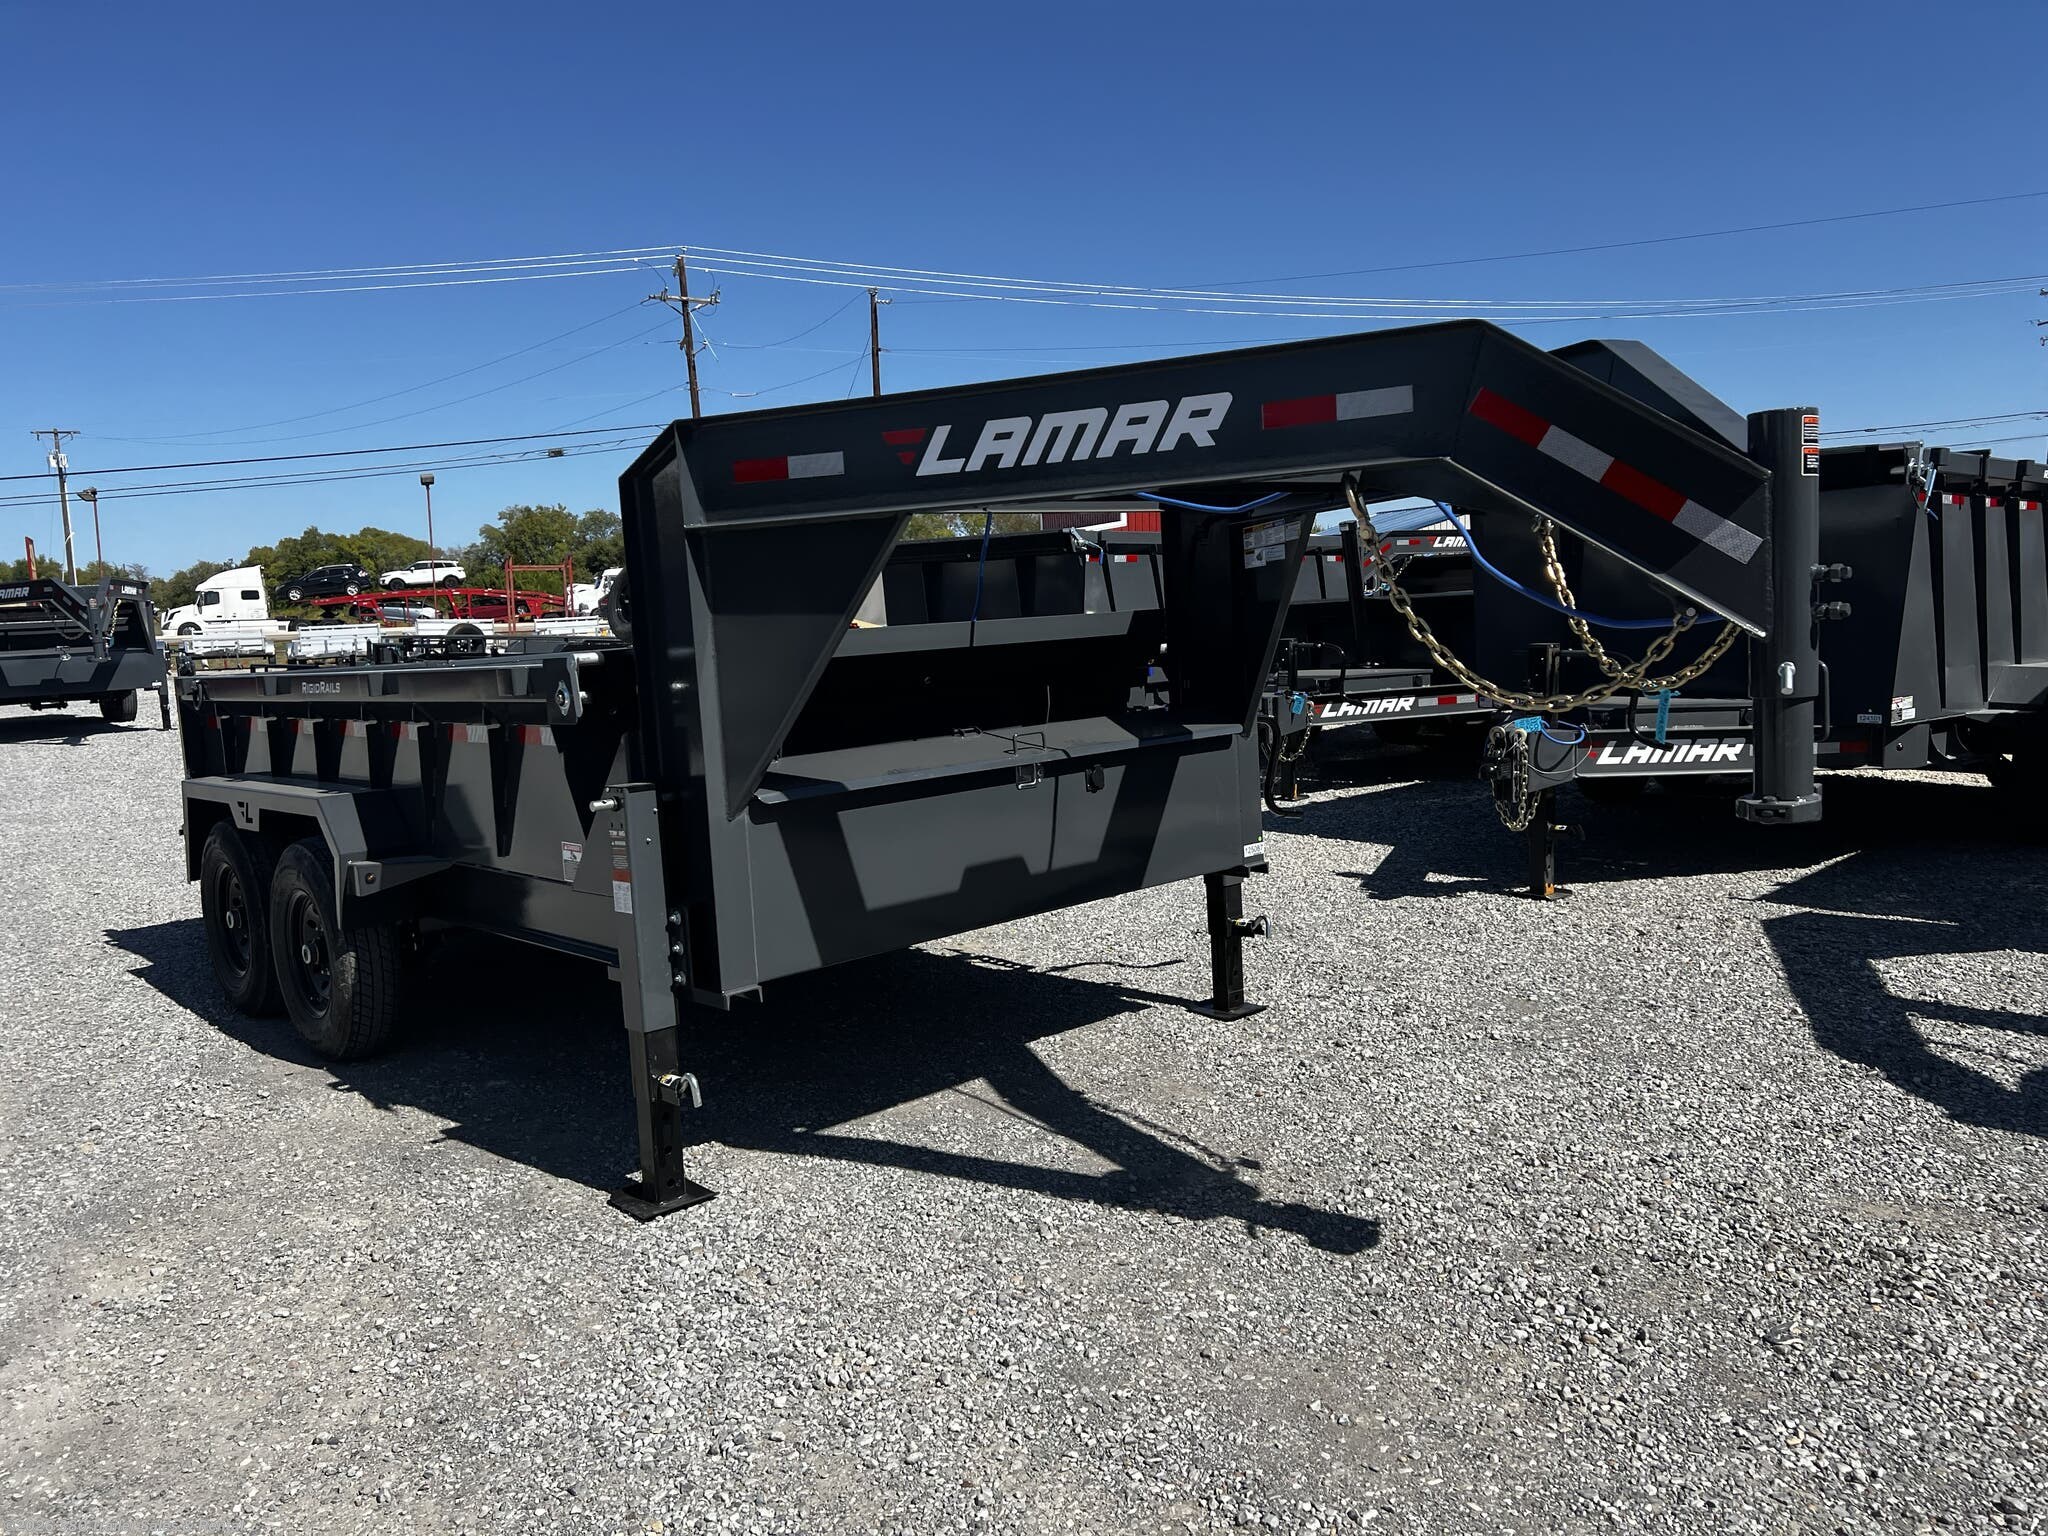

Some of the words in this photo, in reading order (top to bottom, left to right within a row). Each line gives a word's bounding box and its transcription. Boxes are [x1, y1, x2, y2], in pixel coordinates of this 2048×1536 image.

[915, 392, 1233, 476] LAMAR
[1433, 536, 1468, 548] LAM
[1320, 696, 1416, 718] LAMAR
[1596, 738, 1746, 765] LAMAR
